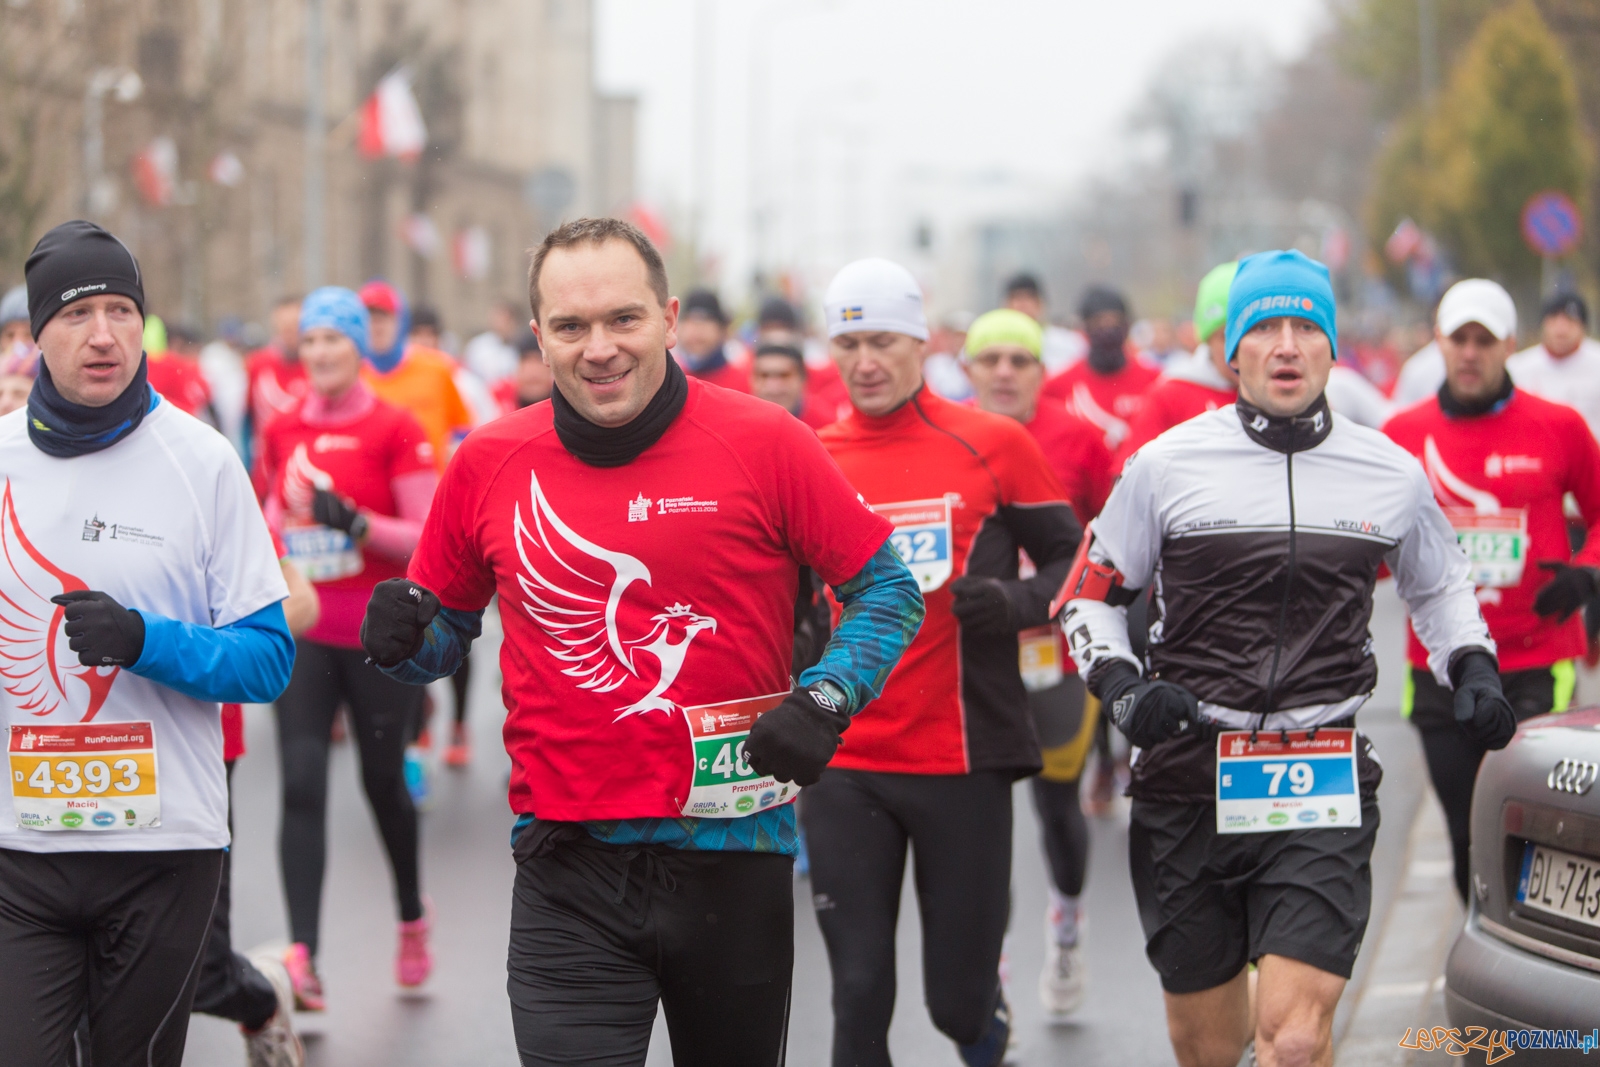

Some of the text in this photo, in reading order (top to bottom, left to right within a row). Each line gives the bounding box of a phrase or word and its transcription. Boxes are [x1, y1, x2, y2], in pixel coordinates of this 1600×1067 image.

[657, 498, 667, 514] 1
[109, 523, 118, 539] 1
[718, 715, 726, 727] 1
[38, 735, 45, 746] 1
[84, 734, 144, 744] RunPoland.org
[698, 757, 708, 770] C
[14, 758, 141, 795] D 4393
[1222, 762, 1315, 796] E 79
[66, 800, 98, 809] Maciej
[21, 819, 45, 827] LUXMED
